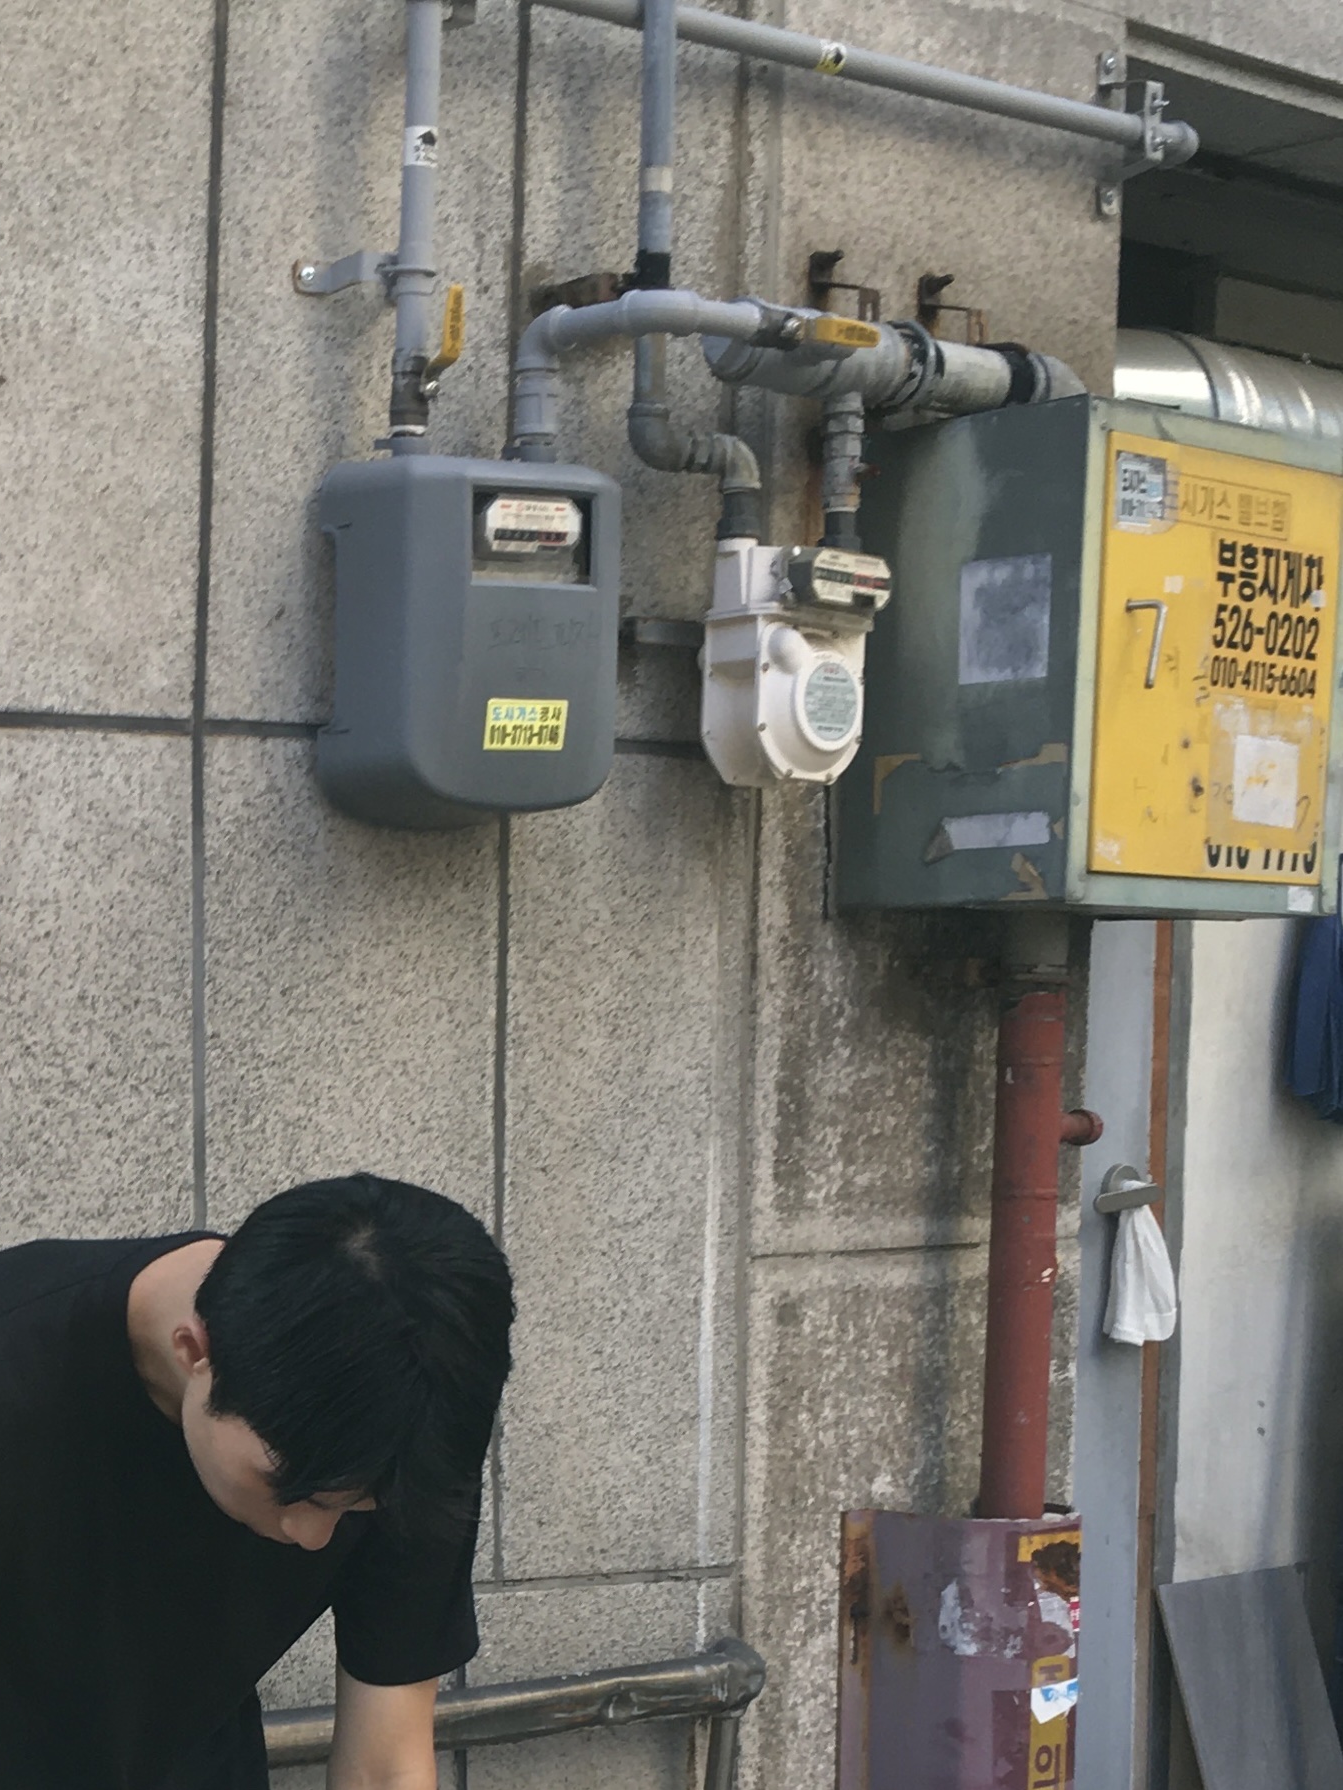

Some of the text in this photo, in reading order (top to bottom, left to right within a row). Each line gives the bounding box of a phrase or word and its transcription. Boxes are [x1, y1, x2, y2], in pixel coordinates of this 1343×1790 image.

[1216, 538, 1324, 612] 부흥지게차
[1213, 603, 1321, 661] 526-0202
[1210, 655, 1318, 699] 010-4115-6604
